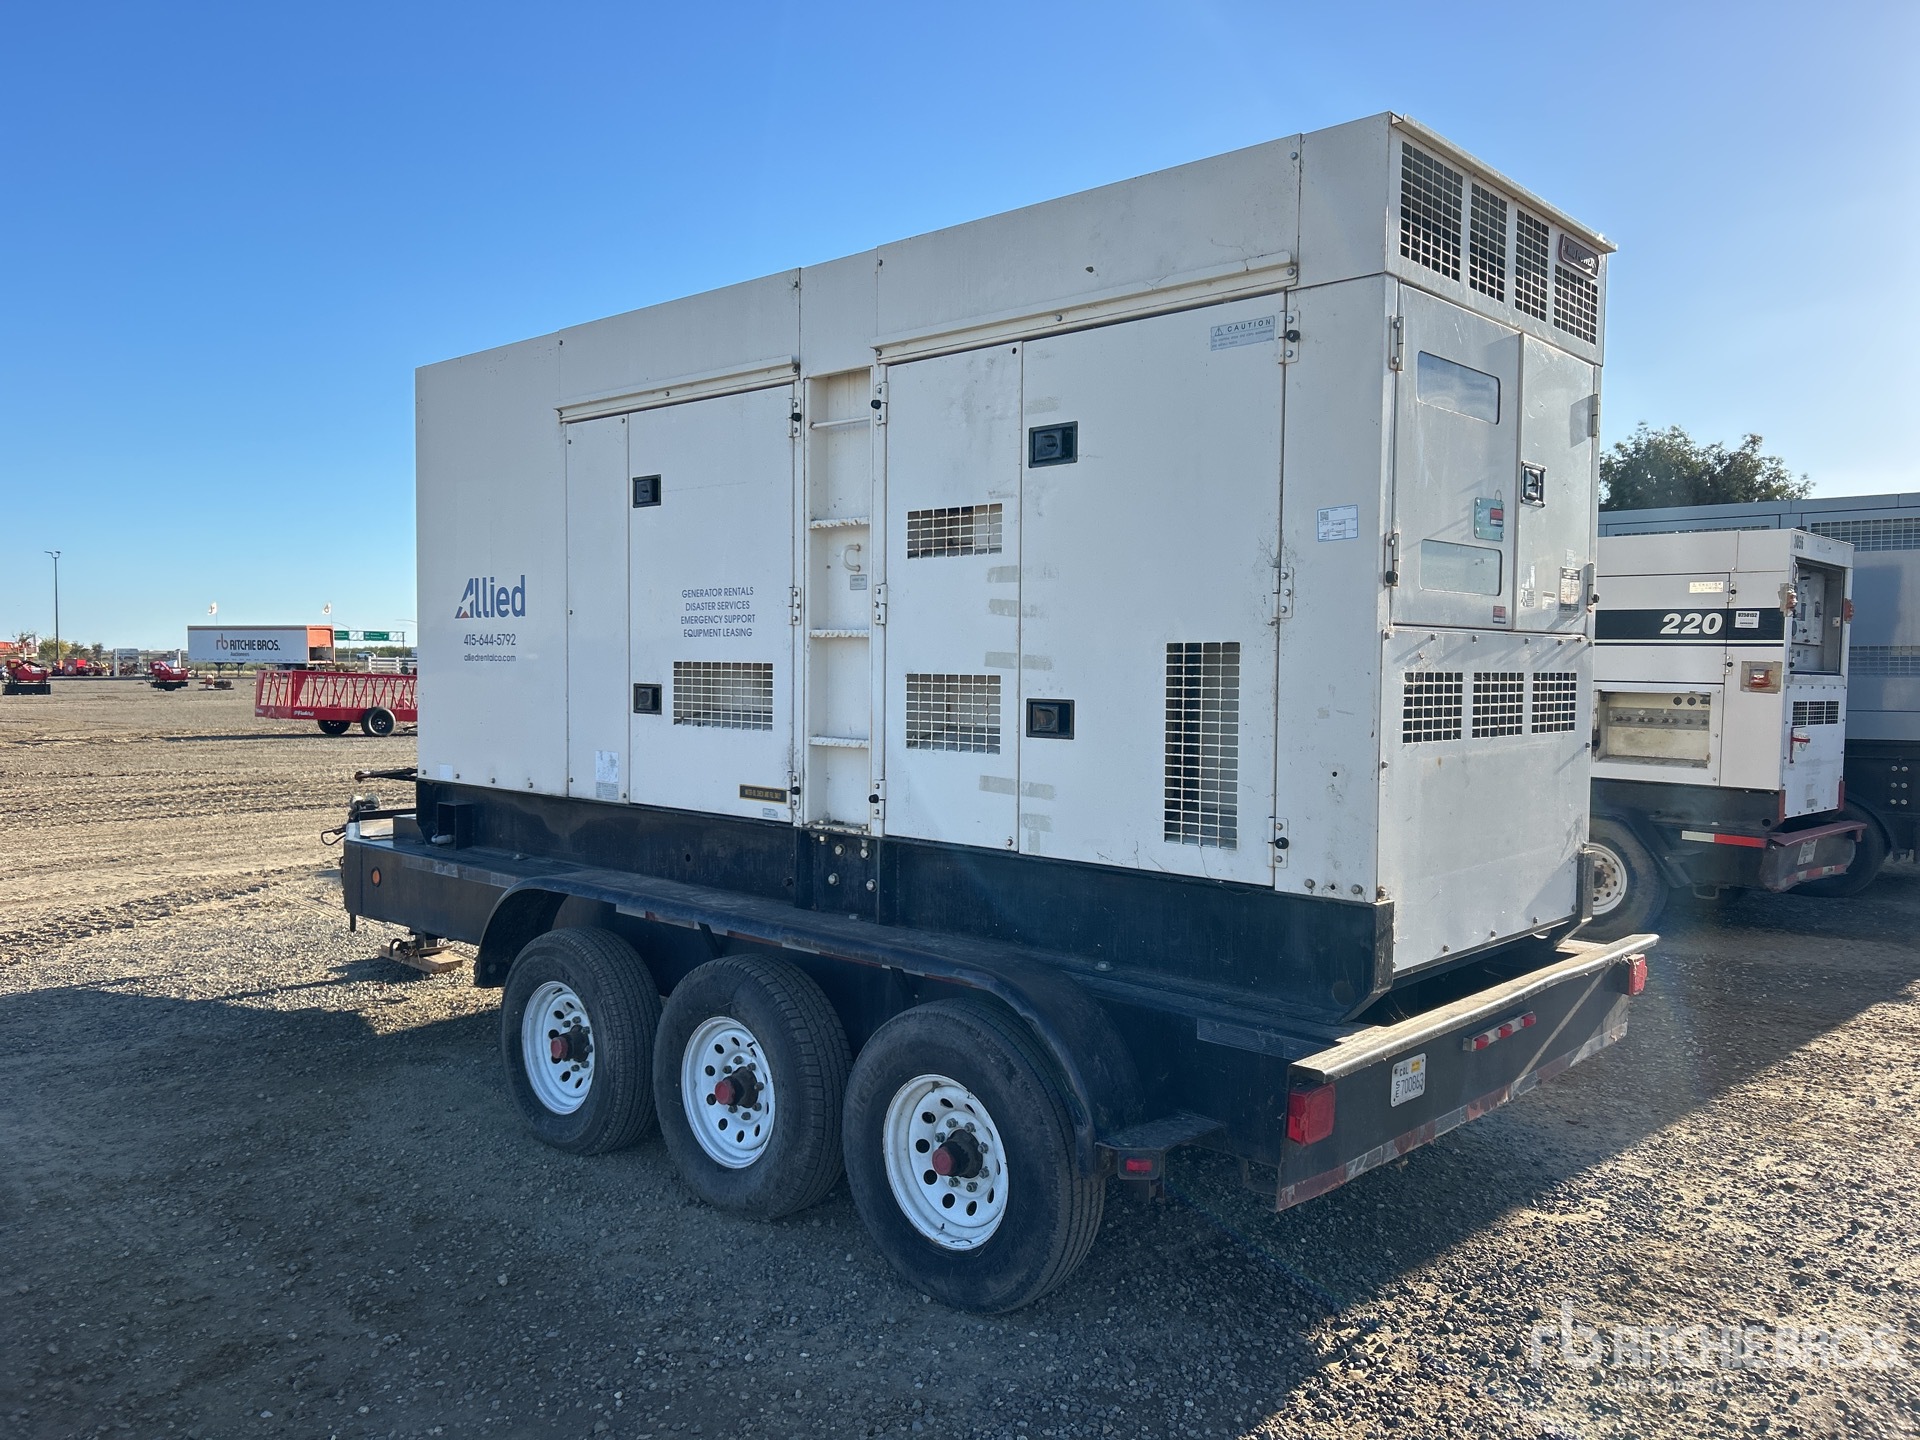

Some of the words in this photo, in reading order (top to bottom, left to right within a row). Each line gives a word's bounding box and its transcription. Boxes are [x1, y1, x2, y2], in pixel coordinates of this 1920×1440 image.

[1227, 319, 1271, 332] CAUTION
[455, 575, 525, 619] Allied
[682, 588, 722, 598] GENERATOR
[724, 587, 754, 597] RENTALS
[686, 602, 716, 611] DISASTER
[717, 601, 750, 610] SERVICES
[681, 615, 722, 625] EMERGENCY
[724, 614, 755, 623] SUPPORT
[1660, 613, 1723, 635] 220
[684, 629, 721, 637] EQUIPMENT
[723, 628, 752, 637] LEASING
[230, 640, 256, 651] RITCHIE
[257, 640, 280, 651] BROS.
[464, 634, 516, 646] 415-644-5792
